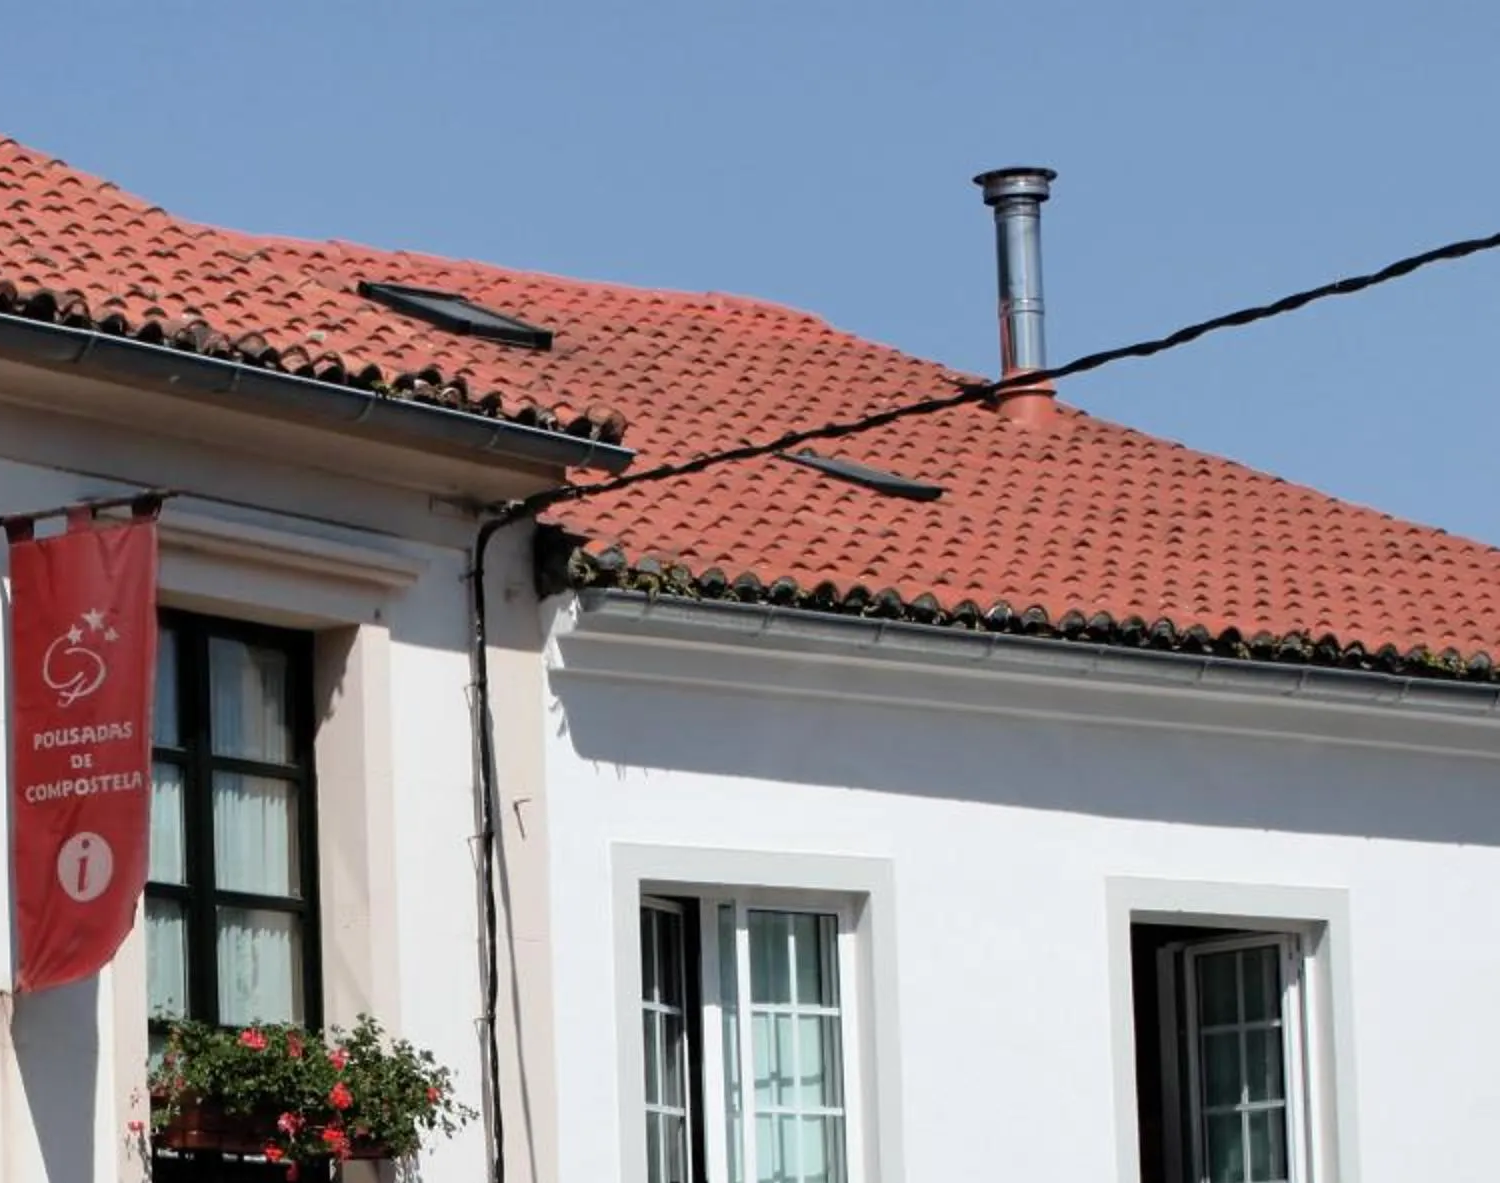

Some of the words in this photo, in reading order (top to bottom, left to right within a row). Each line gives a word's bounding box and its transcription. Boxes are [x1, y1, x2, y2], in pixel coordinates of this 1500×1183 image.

[33, 721, 133, 751] POUSADAS
[70, 753, 93, 769] DE
[25, 771, 143, 803] COMPOSTELA
